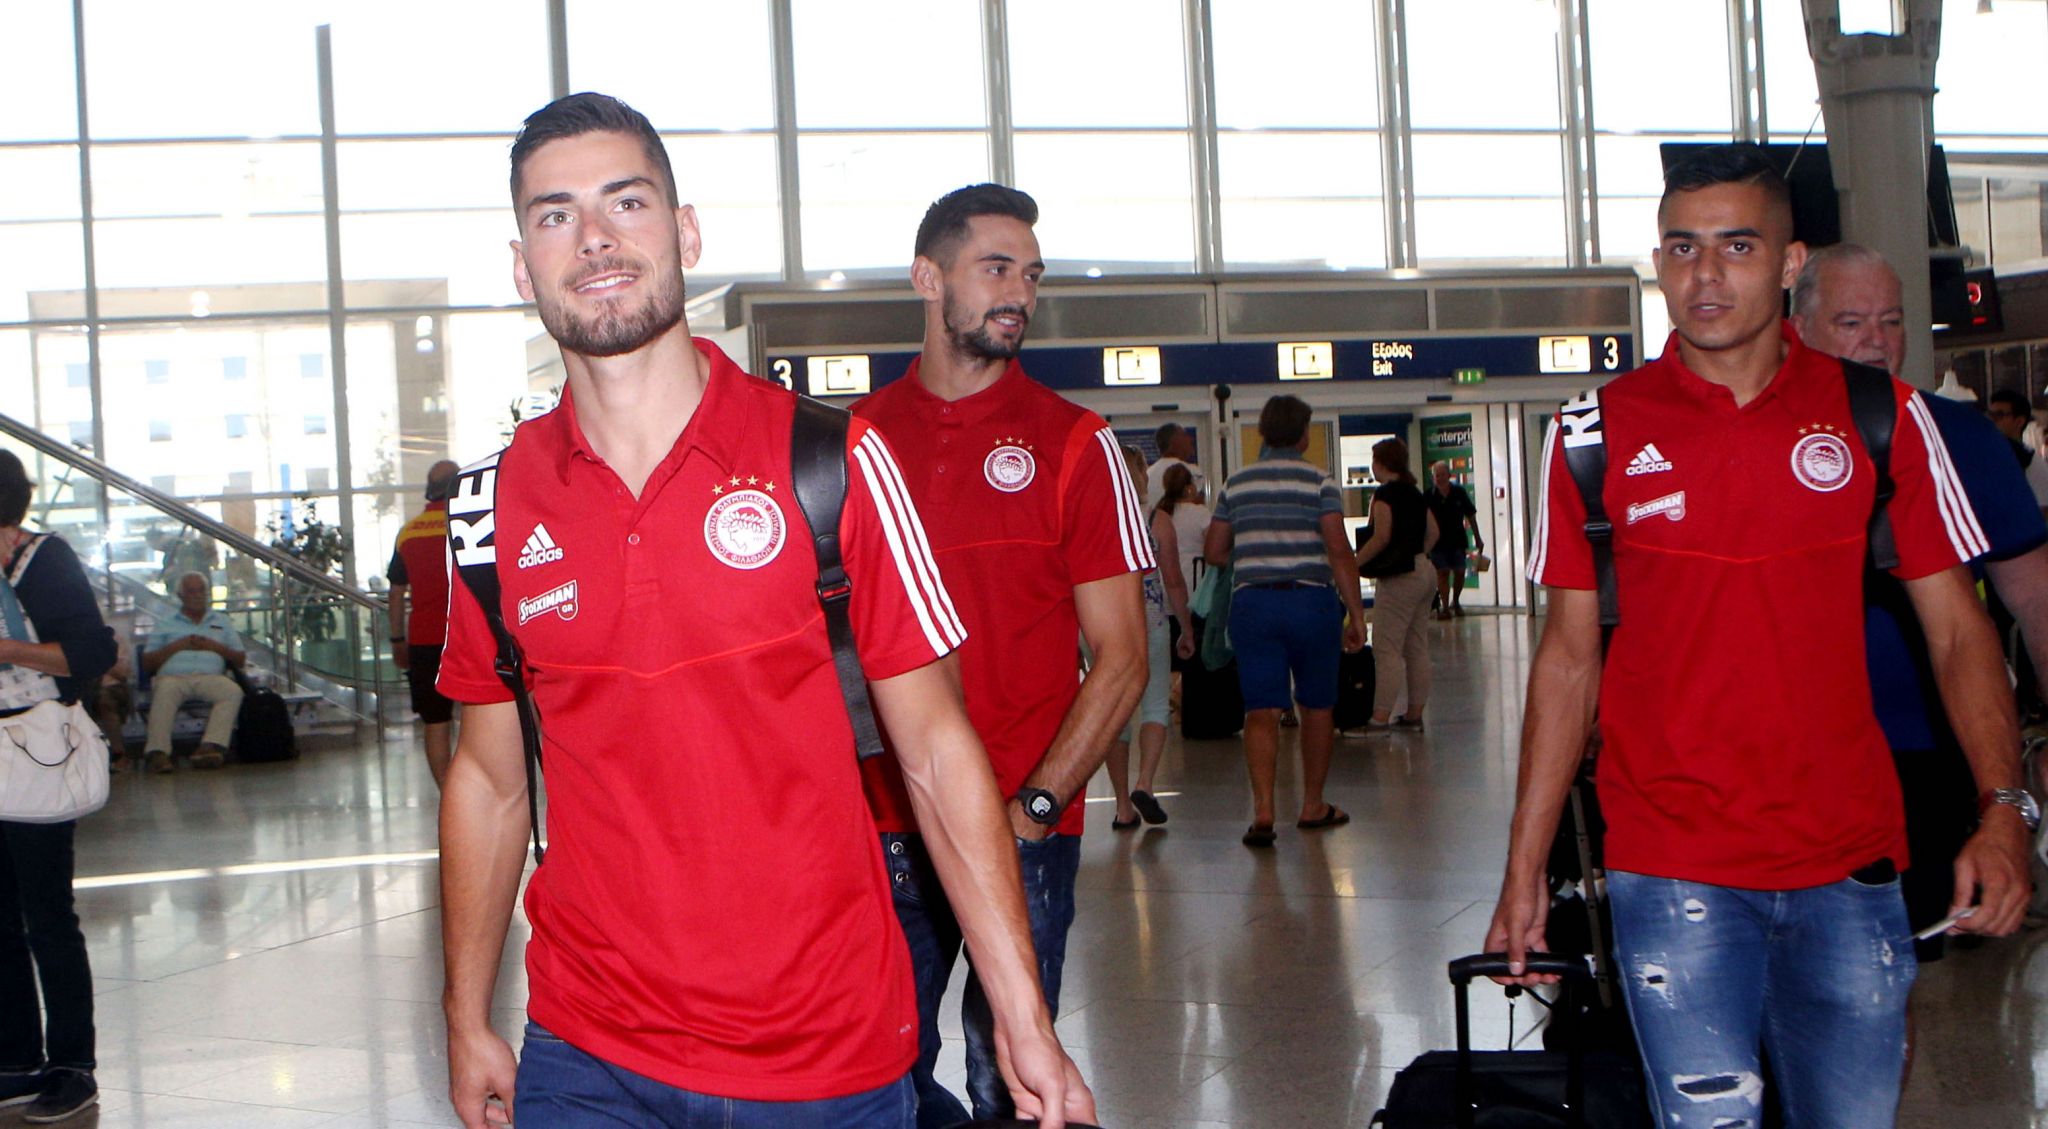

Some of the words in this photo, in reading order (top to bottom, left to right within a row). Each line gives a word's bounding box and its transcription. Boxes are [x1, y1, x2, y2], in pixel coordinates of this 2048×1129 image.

[1603, 336, 1619, 370] 3
[773, 359, 793, 391] 3
[1373, 360, 1393, 376] Exit
[1429, 428, 1471, 444] enterpri
[1626, 461, 1673, 476] adidas
[449, 455, 499, 567] RE
[518, 548, 563, 568] adidas
[561, 604, 573, 613] GR
